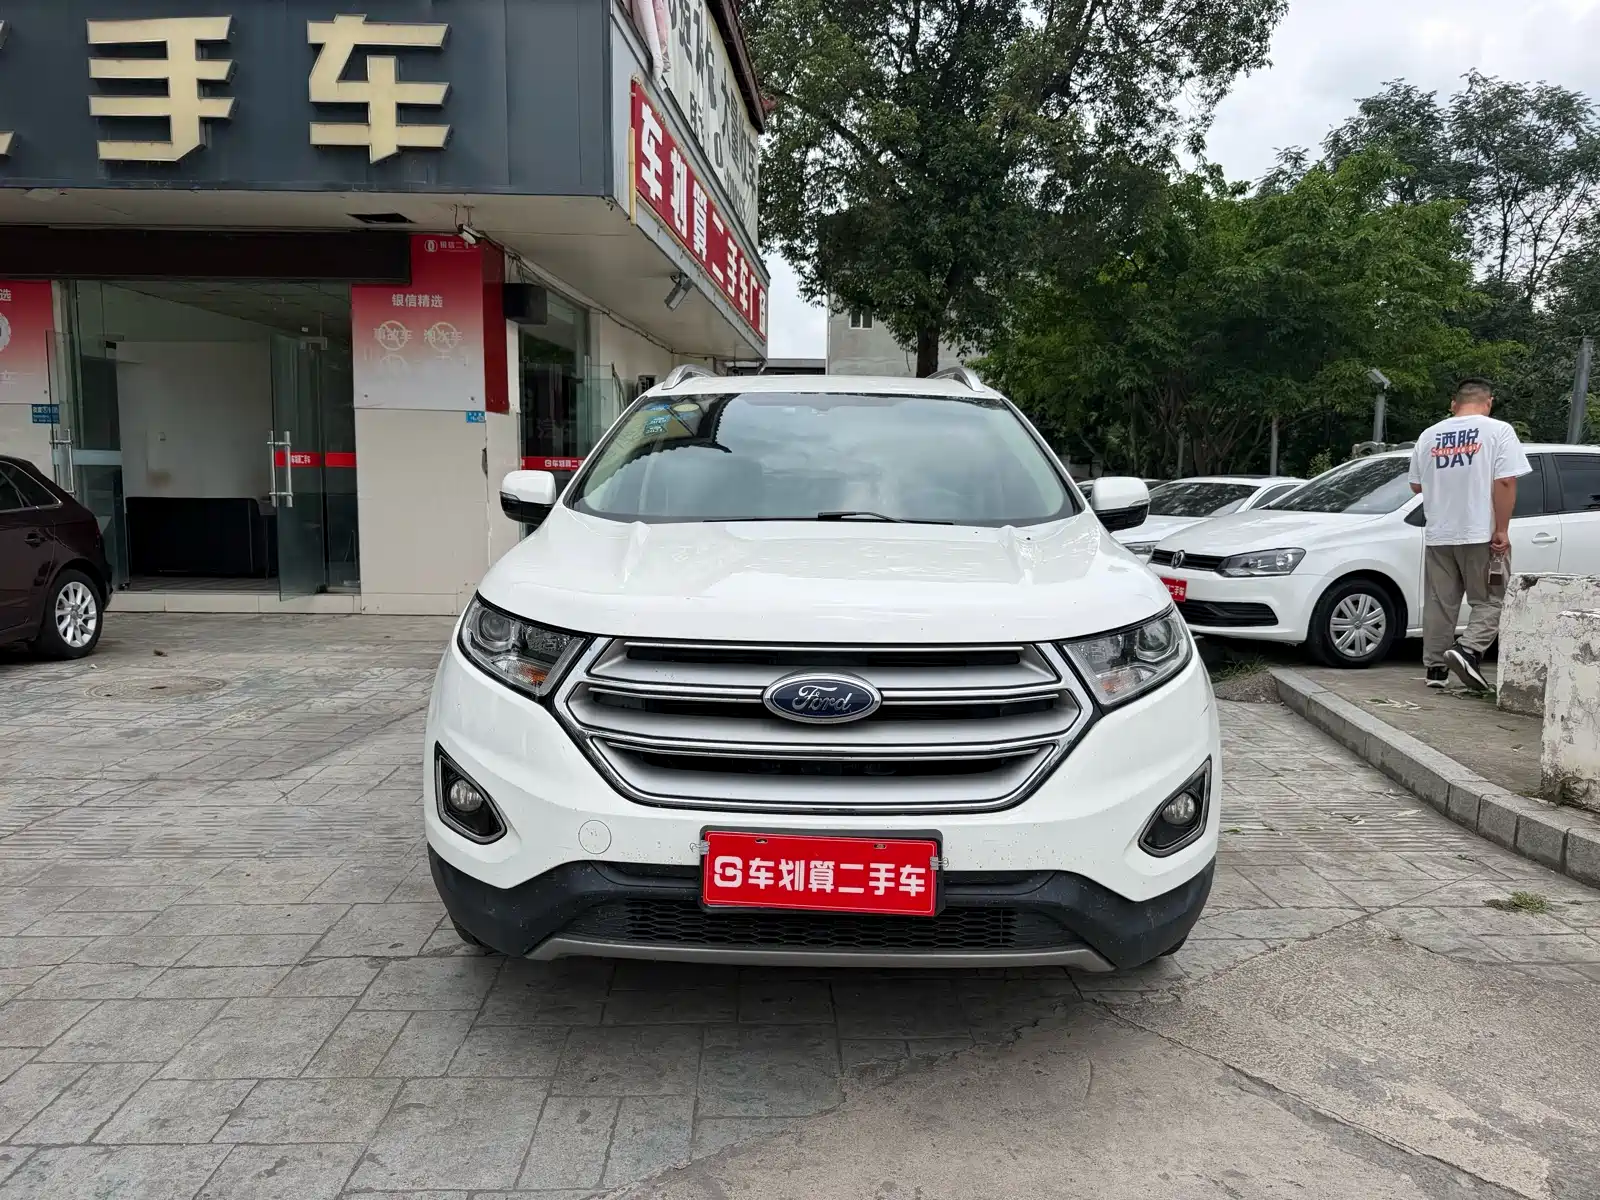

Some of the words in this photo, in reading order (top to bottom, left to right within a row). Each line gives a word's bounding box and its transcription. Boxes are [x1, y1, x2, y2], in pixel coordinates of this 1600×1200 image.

[0, 14, 450, 164] 手车
[391, 293, 443, 308] 银信精选
[1435, 451, 1476, 469] DAY
[791, 685, 852, 711] Ford
[748, 857, 926, 897] 车划算二手车
